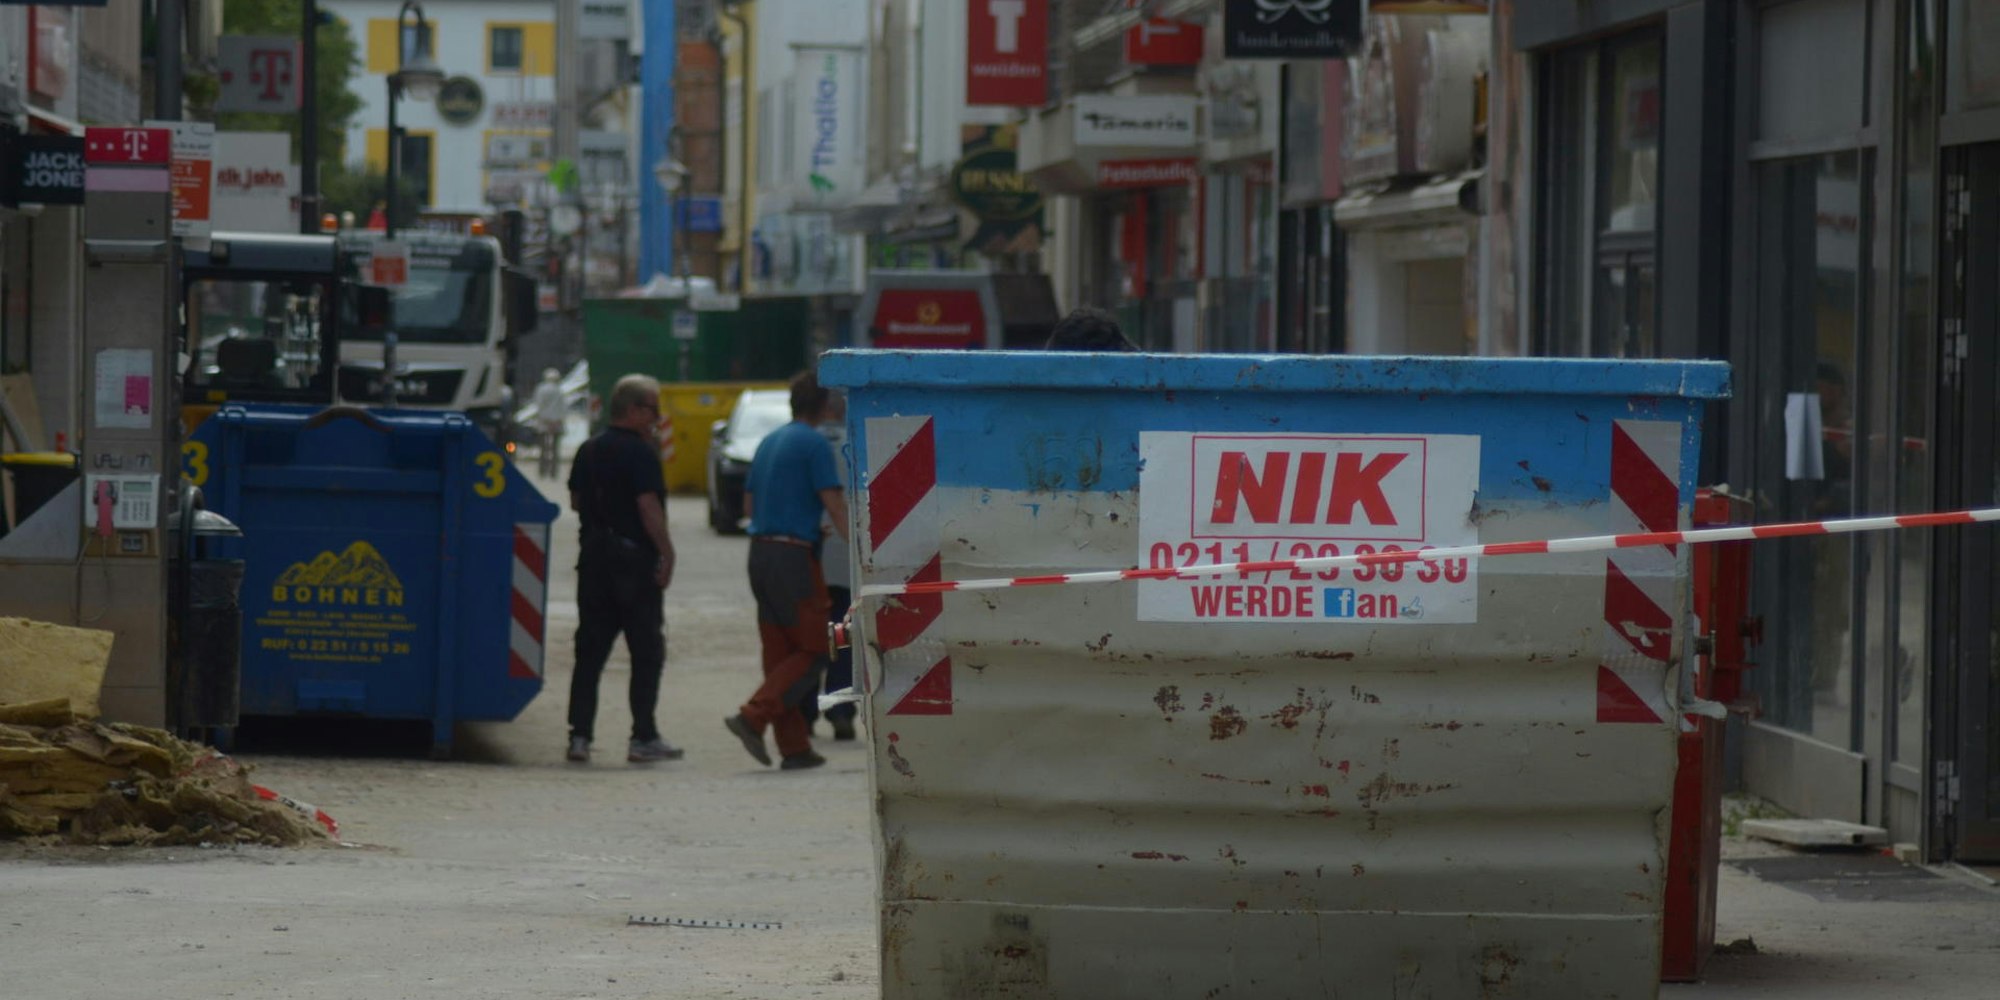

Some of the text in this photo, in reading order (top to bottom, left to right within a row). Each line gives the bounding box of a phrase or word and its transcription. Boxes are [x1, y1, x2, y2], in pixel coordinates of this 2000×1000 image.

[23, 151, 81, 169] JACK
[23, 169, 84, 187] JONE
[181, 441, 209, 487] 3
[472, 451, 507, 499] 3
[1210, 451, 1410, 526] NIK
[1150, 542, 1249, 580] 0211
[1353, 544, 1404, 583] 30
[272, 584, 404, 607] BOHNEN
[1190, 586, 1314, 618] WERDE
